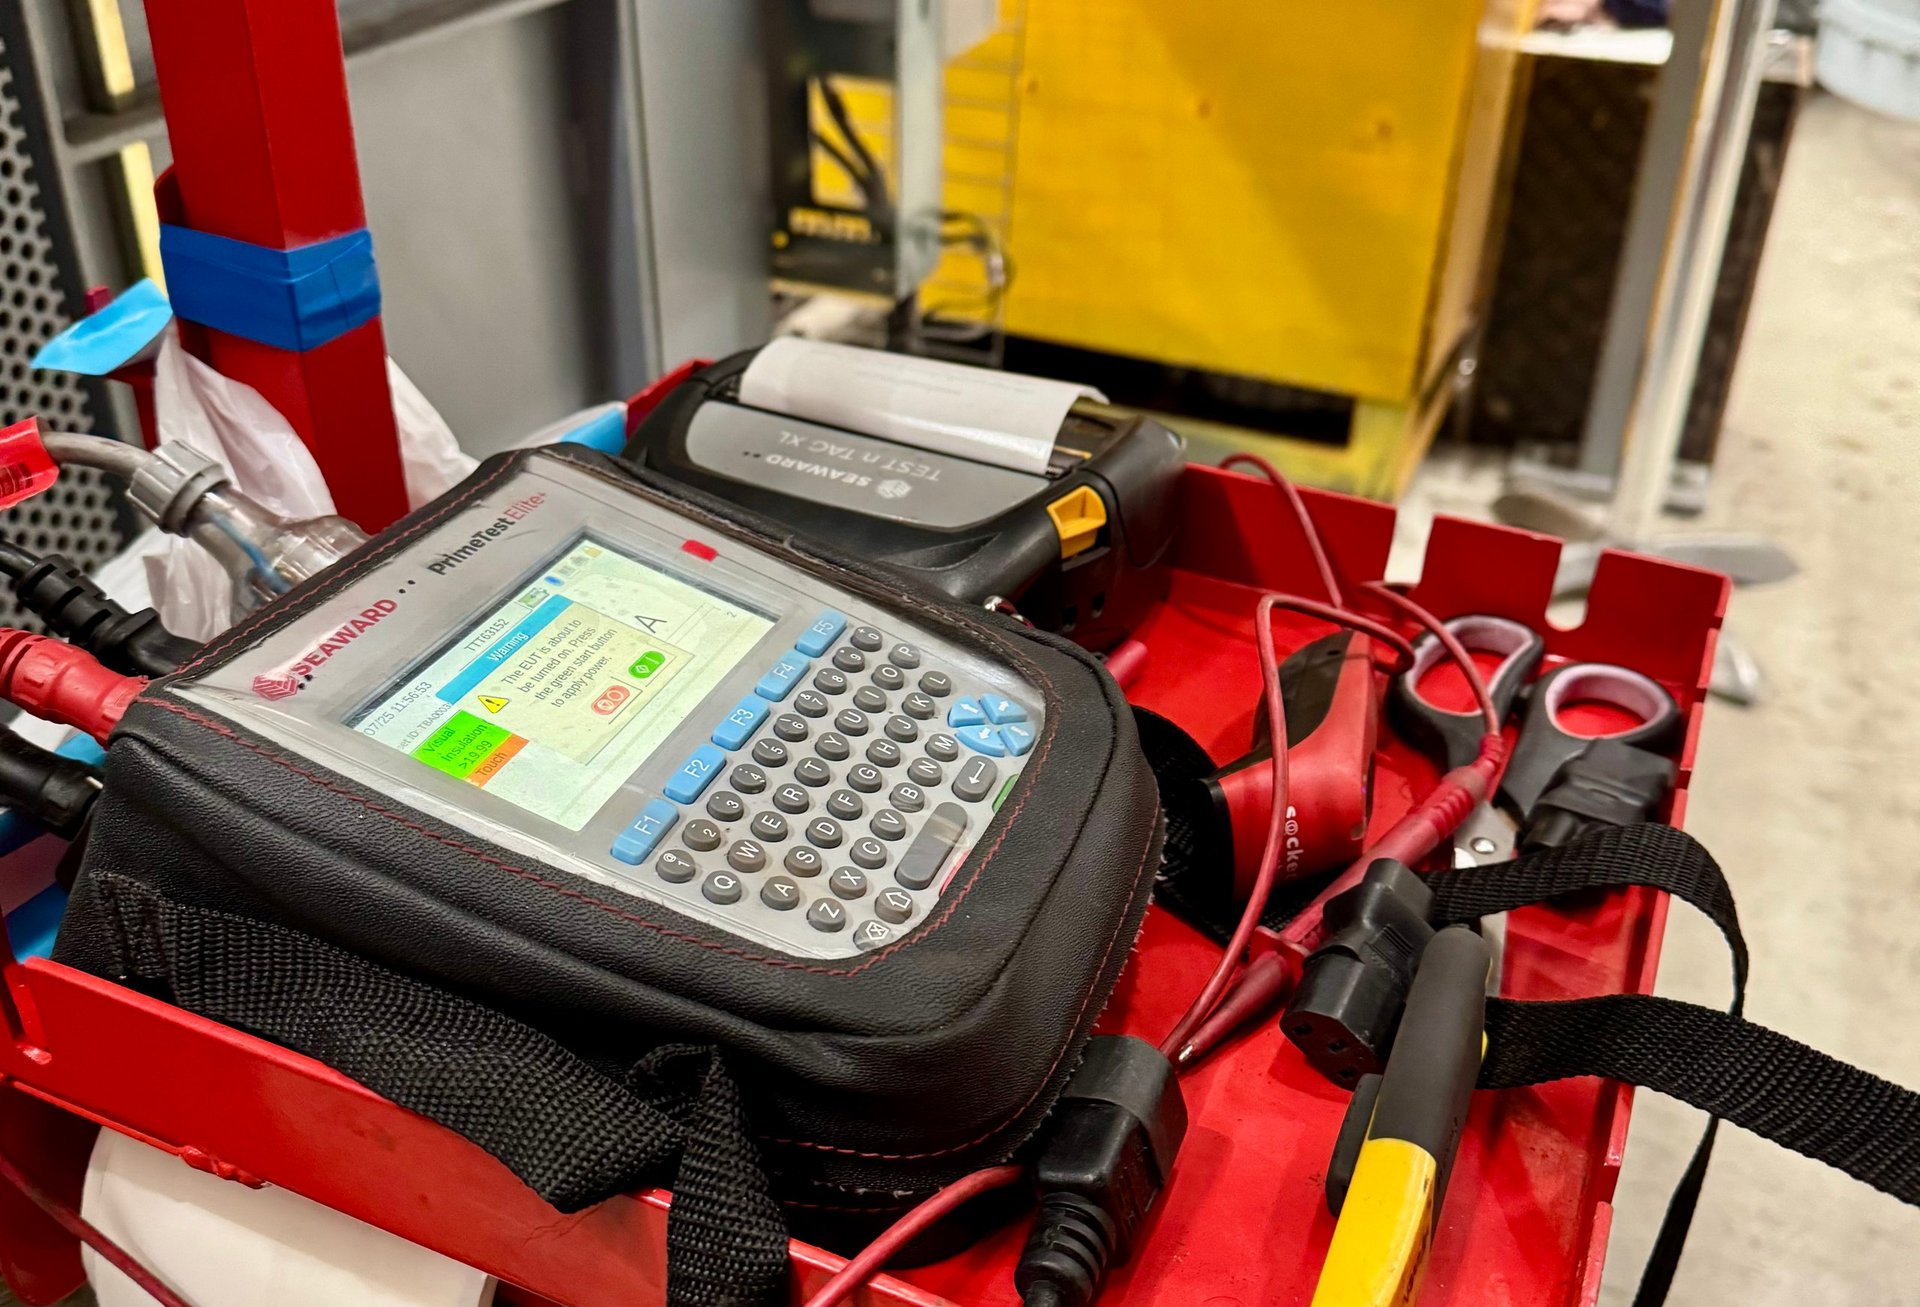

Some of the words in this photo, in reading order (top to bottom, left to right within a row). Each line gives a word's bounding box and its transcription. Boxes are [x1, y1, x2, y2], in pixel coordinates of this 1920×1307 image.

[778, 431, 804, 447] XL
[862, 452, 880, 463] n
[766, 454, 872, 487] SEAWARD
[882, 459, 943, 482] TEST
[427, 517, 516, 576] PrimeTest
[634, 614, 668, 634] A
[813, 619, 834, 636] F5
[291, 599, 398, 676] SEAWARD
[464, 618, 510, 652] TTT63152
[487, 632, 530, 662] Warning
[501, 670, 524, 685] The
[518, 651, 542, 671] EUT
[537, 646, 551, 655] is
[548, 626, 573, 647] about
[568, 619, 582, 632] to
[898, 646, 914, 657] P
[517, 682, 535, 693] be
[531, 658, 560, 682] turned
[568, 626, 596, 648] Press
[535, 686, 554, 700] the
[550, 665, 576, 689] green
[573, 650, 596, 667] start
[588, 628, 618, 651] button
[850, 653, 862, 661] 9
[772, 662, 796, 680] F4
[882, 668, 898, 678] O
[551, 698, 564, 708] to
[562, 678, 588, 700] apply
[584, 656, 612, 680] power.
[832, 675, 844, 683] 8
[930, 676, 946, 685] L
[391, 682, 432, 713] 11:56:53
[812, 698, 824, 706] 7
[912, 695, 930, 707] K
[730, 708, 754, 726] F3
[844, 711, 862, 724] U
[896, 718, 912, 730] J
[792, 722, 804, 730] 6
[422, 727, 456, 753] Visual
[441, 724, 488, 762] Insulation
[824, 735, 842, 747] Y
[934, 736, 954, 750] M
[459, 740, 493, 770] >19.99
[771, 746, 783, 755] 5
[876, 742, 896, 755] H
[475, 751, 508, 778] Touch
[684, 759, 710, 778] F2
[804, 760, 822, 772] T
[918, 760, 938, 774] N
[750, 772, 762, 781] 4
[858, 767, 878, 779] G
[783, 787, 803, 801] R
[838, 793, 854, 807] F
[900, 787, 918, 800] B
[726, 800, 740, 809] 3
[634, 815, 661, 835] F1
[762, 815, 782, 830] E
[880, 812, 900, 826] V
[704, 828, 717, 838] 2
[816, 822, 835, 836] D
[736, 841, 760, 859] W
[862, 842, 880, 855] C
[678, 860, 691, 868] 1
[796, 850, 815, 864] S
[714, 875, 736, 889] Q
[840, 870, 862, 886] X
[774, 883, 794, 897] A
[819, 902, 840, 918] Z
